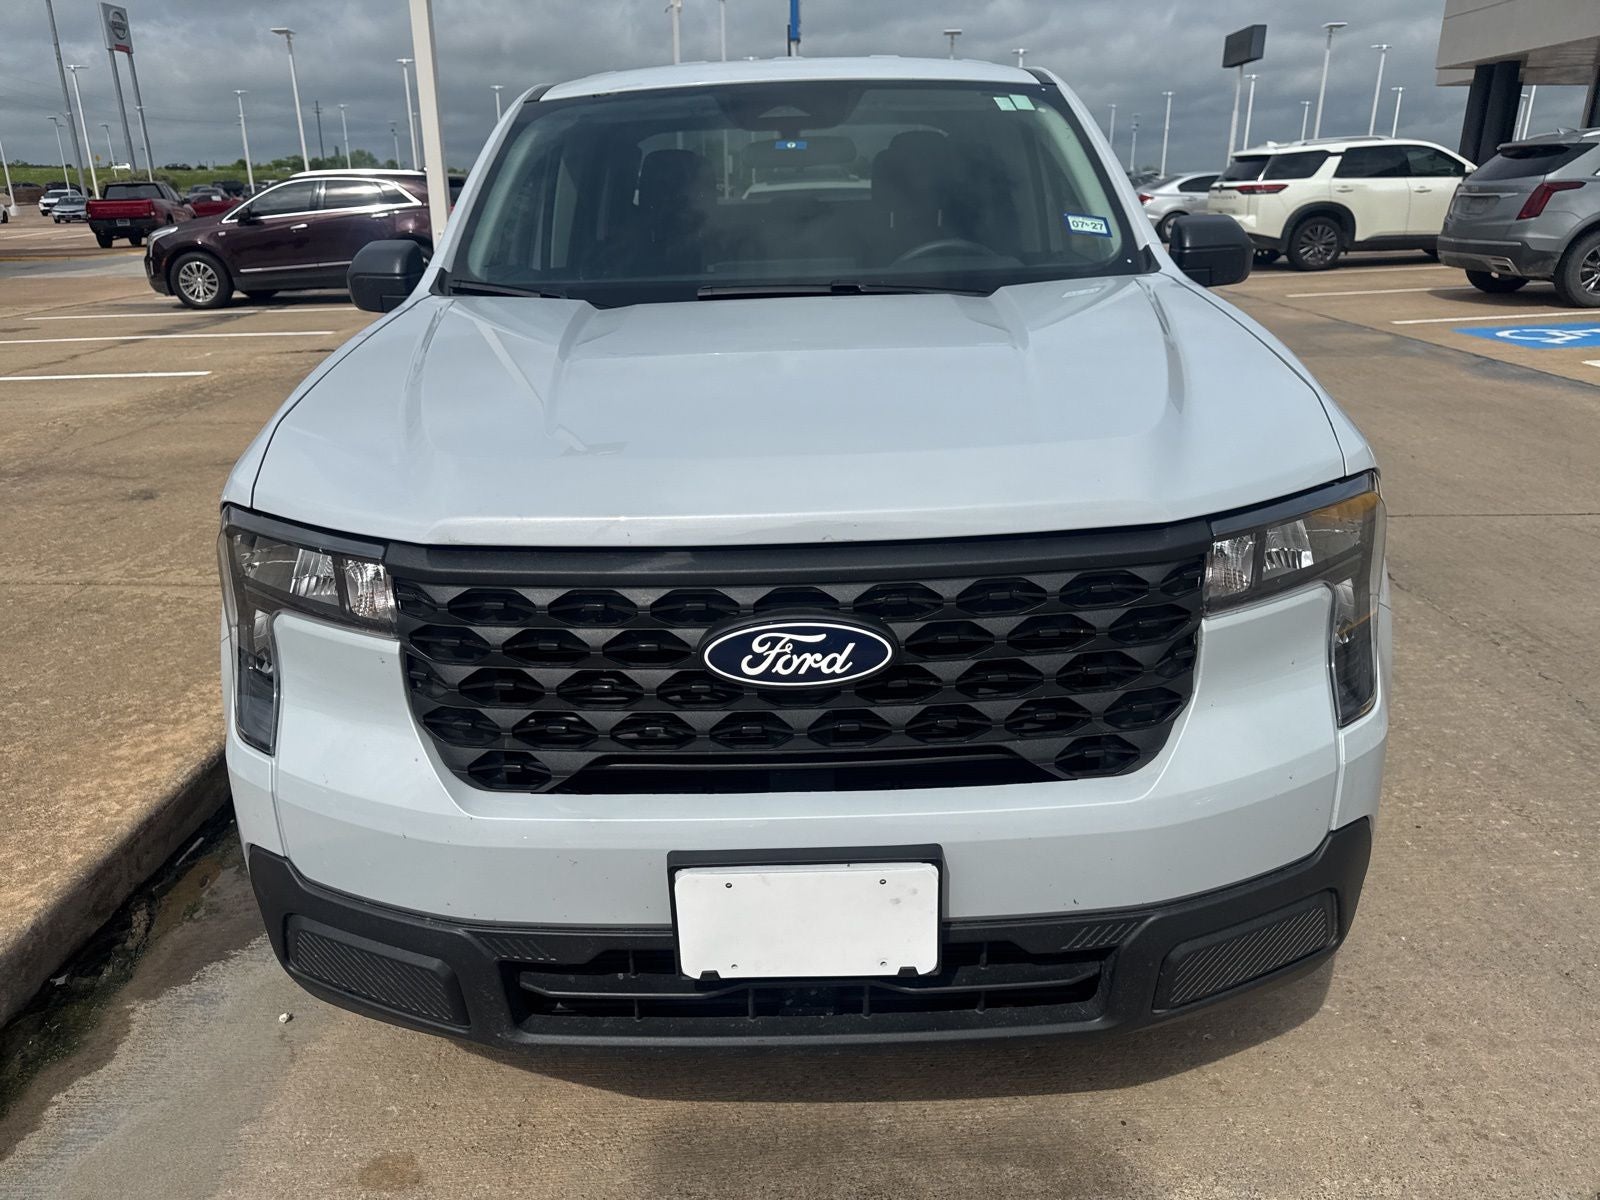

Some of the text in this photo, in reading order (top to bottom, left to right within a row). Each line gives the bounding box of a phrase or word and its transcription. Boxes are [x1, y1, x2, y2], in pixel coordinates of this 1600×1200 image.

[1071, 220, 1104, 231] 07 27
[740, 632, 856, 676] Ford
